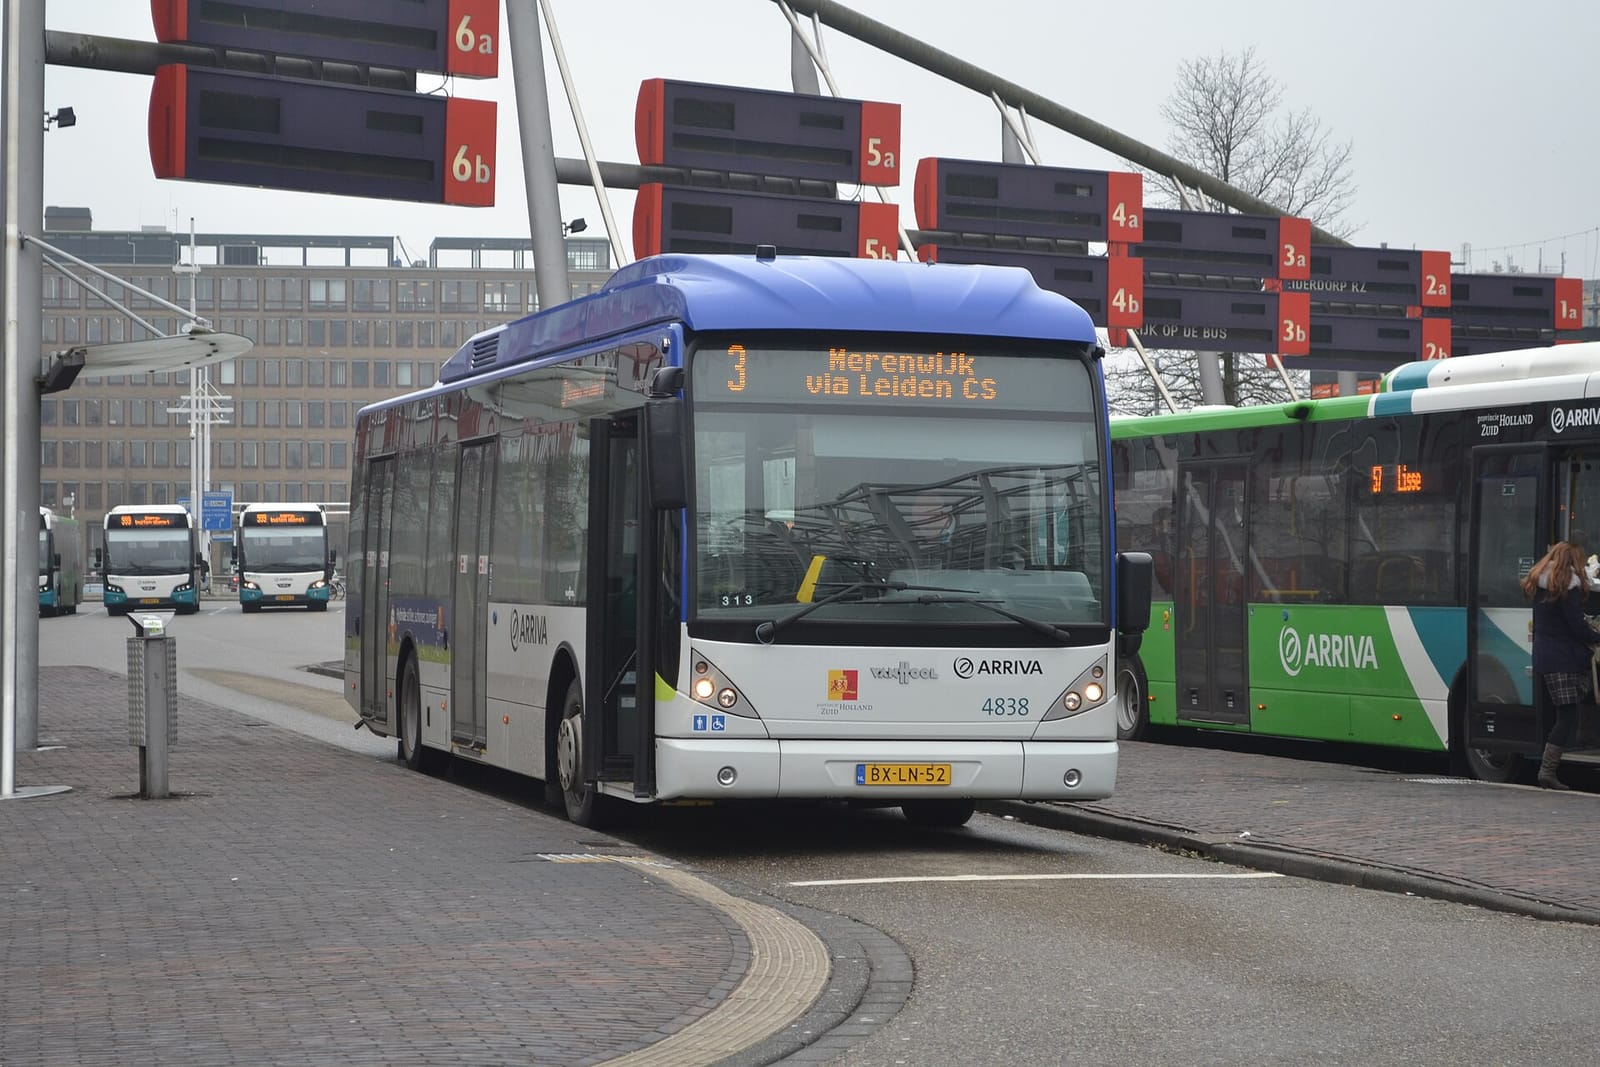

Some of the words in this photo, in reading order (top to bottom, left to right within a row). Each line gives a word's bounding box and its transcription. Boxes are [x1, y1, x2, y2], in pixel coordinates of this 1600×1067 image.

[455, 15, 493, 54] 6a
[452, 145, 491, 183] 6b
[867, 137, 895, 168] 5a
[1112, 202, 1139, 229] 4a
[1283, 243, 1307, 267] 3a
[1425, 275, 1447, 295] 2a
[1112, 288, 1140, 313] 4b
[1560, 300, 1578, 319] 1a
[1162, 324, 1178, 337] OP
[1183, 326, 1198, 338] DE
[1203, 327, 1228, 340] BUS
[1283, 319, 1307, 343] 3b
[727, 343, 746, 392] 3
[806, 372, 849, 395] via
[859, 373, 952, 399] Leiden
[1477, 413, 1499, 424] provincie
[1481, 424, 1499, 437] ZUID
[1499, 413, 1534, 427] HOLLAND
[1565, 407, 1600, 427] ARRIV
[1397, 464, 1422, 492] Lisse
[519, 614, 548, 645] ARRIVA
[1304, 633, 1379, 669] ARRIVA
[977, 660, 1043, 675] ARRIVA
[839, 703, 873, 711] HOLLAND
[981, 697, 1030, 716] 4838
[871, 767, 946, 782] BX-LN-52
